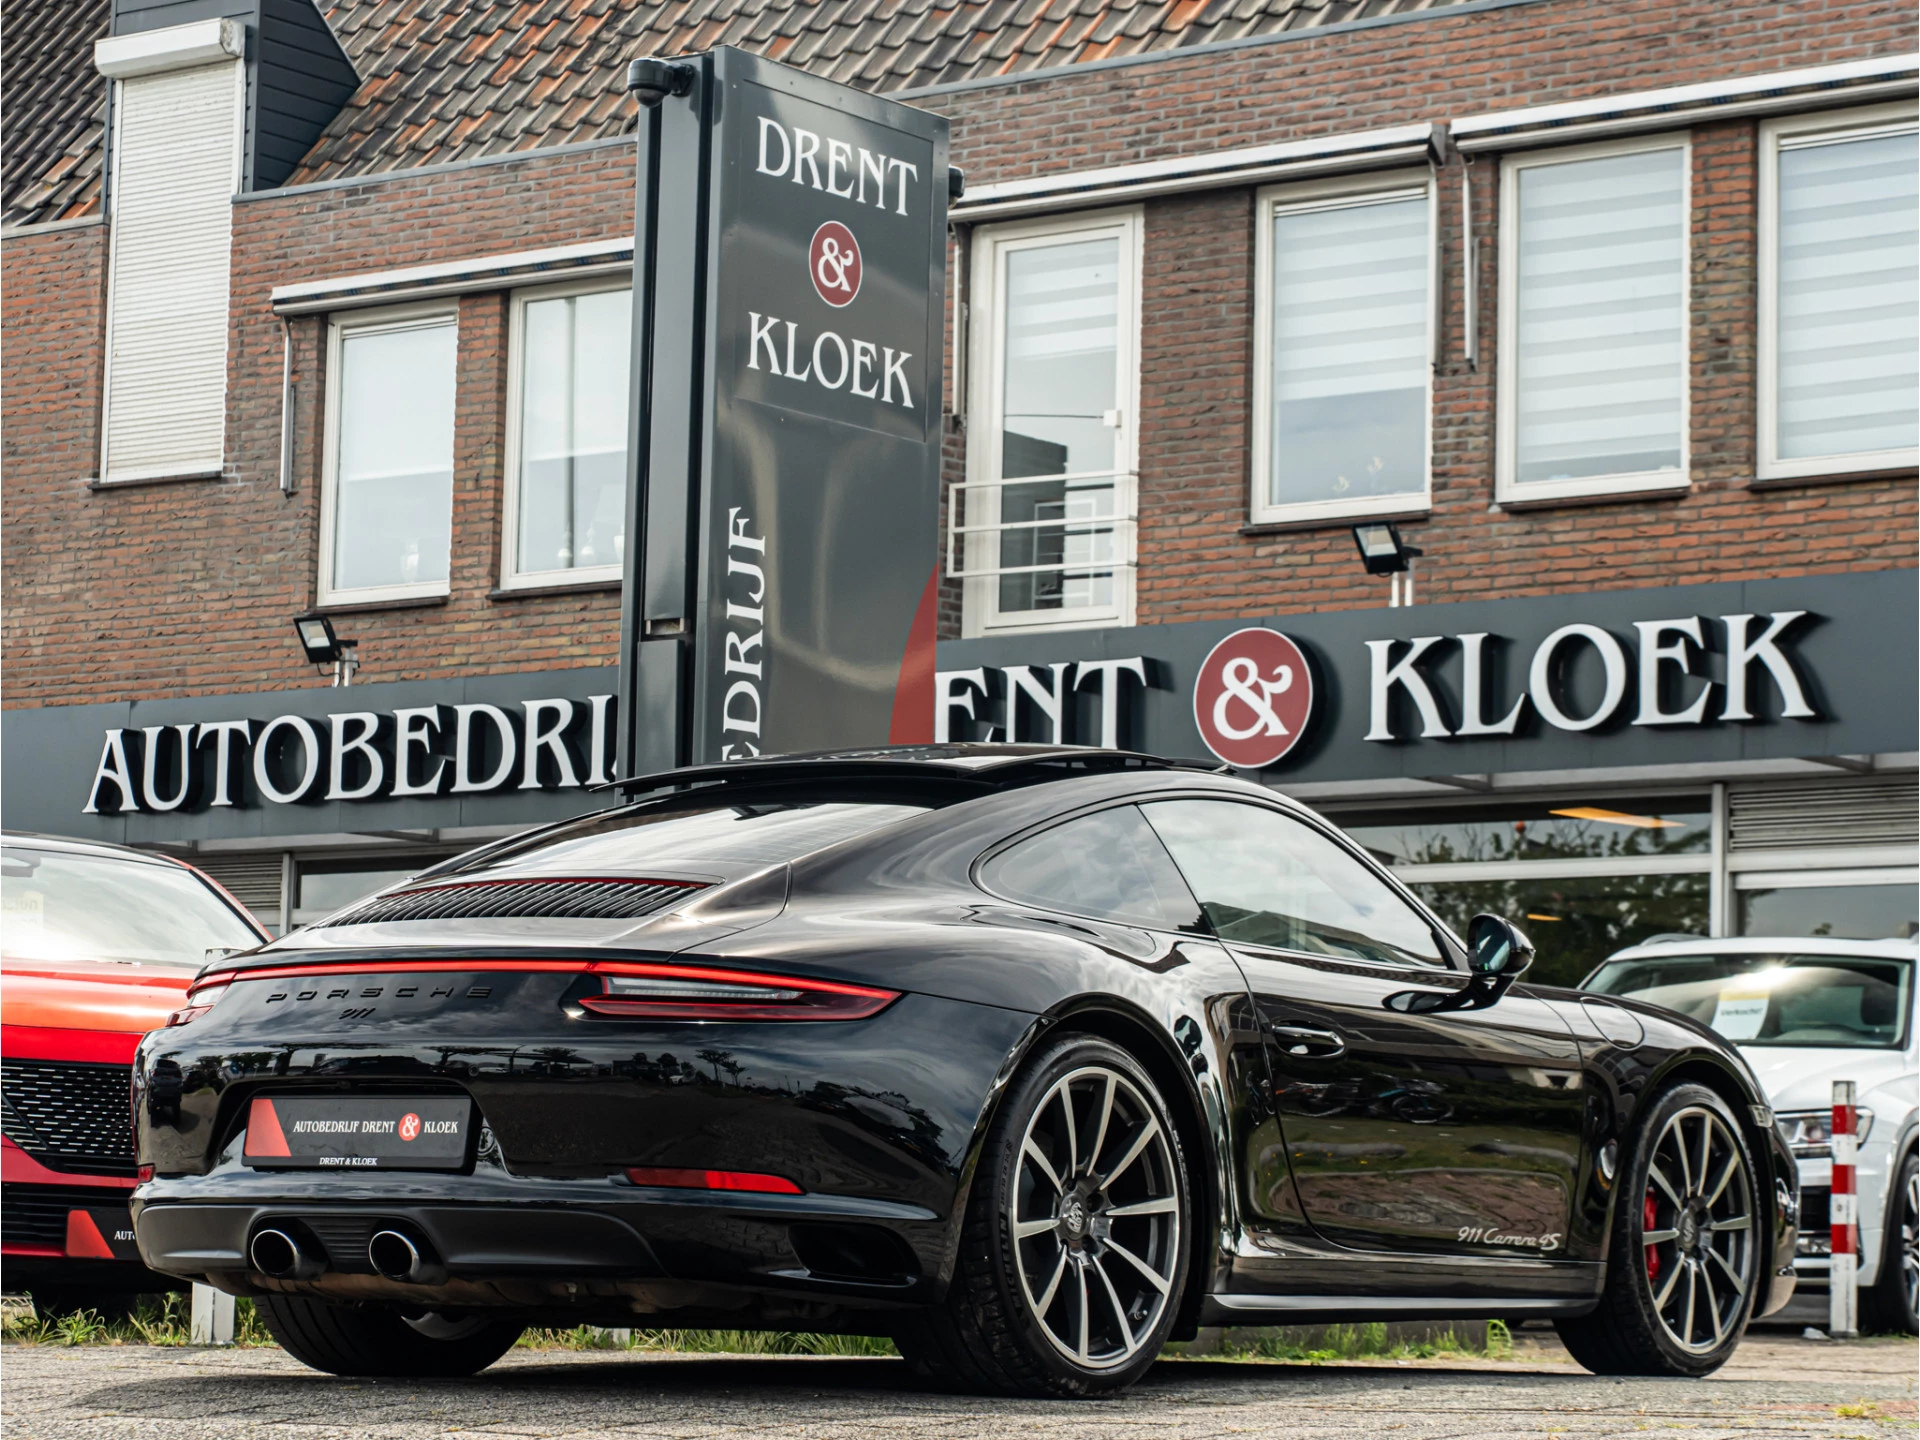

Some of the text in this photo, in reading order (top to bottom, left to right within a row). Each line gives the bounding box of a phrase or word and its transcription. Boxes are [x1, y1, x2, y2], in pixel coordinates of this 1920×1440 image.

[755, 115, 918, 216] DRENT
[817, 236, 854, 292] &
[747, 311, 914, 408] KLOEK
[82, 694, 618, 814] AUTOBEDRI
[1212, 656, 1293, 740] &
[1363, 610, 1816, 741] KLOEK
[266, 986, 493, 1004] PORSCHE
[338, 1007, 376, 1020] 911
[293, 1115, 459, 1138] AUTOBEDRIJF DRENT & KLOEK
[319, 1157, 345, 1165] DRENT
[352, 1157, 377, 1166] KLOEK
[1458, 1226, 1562, 1251] 911 Carrera 4S
